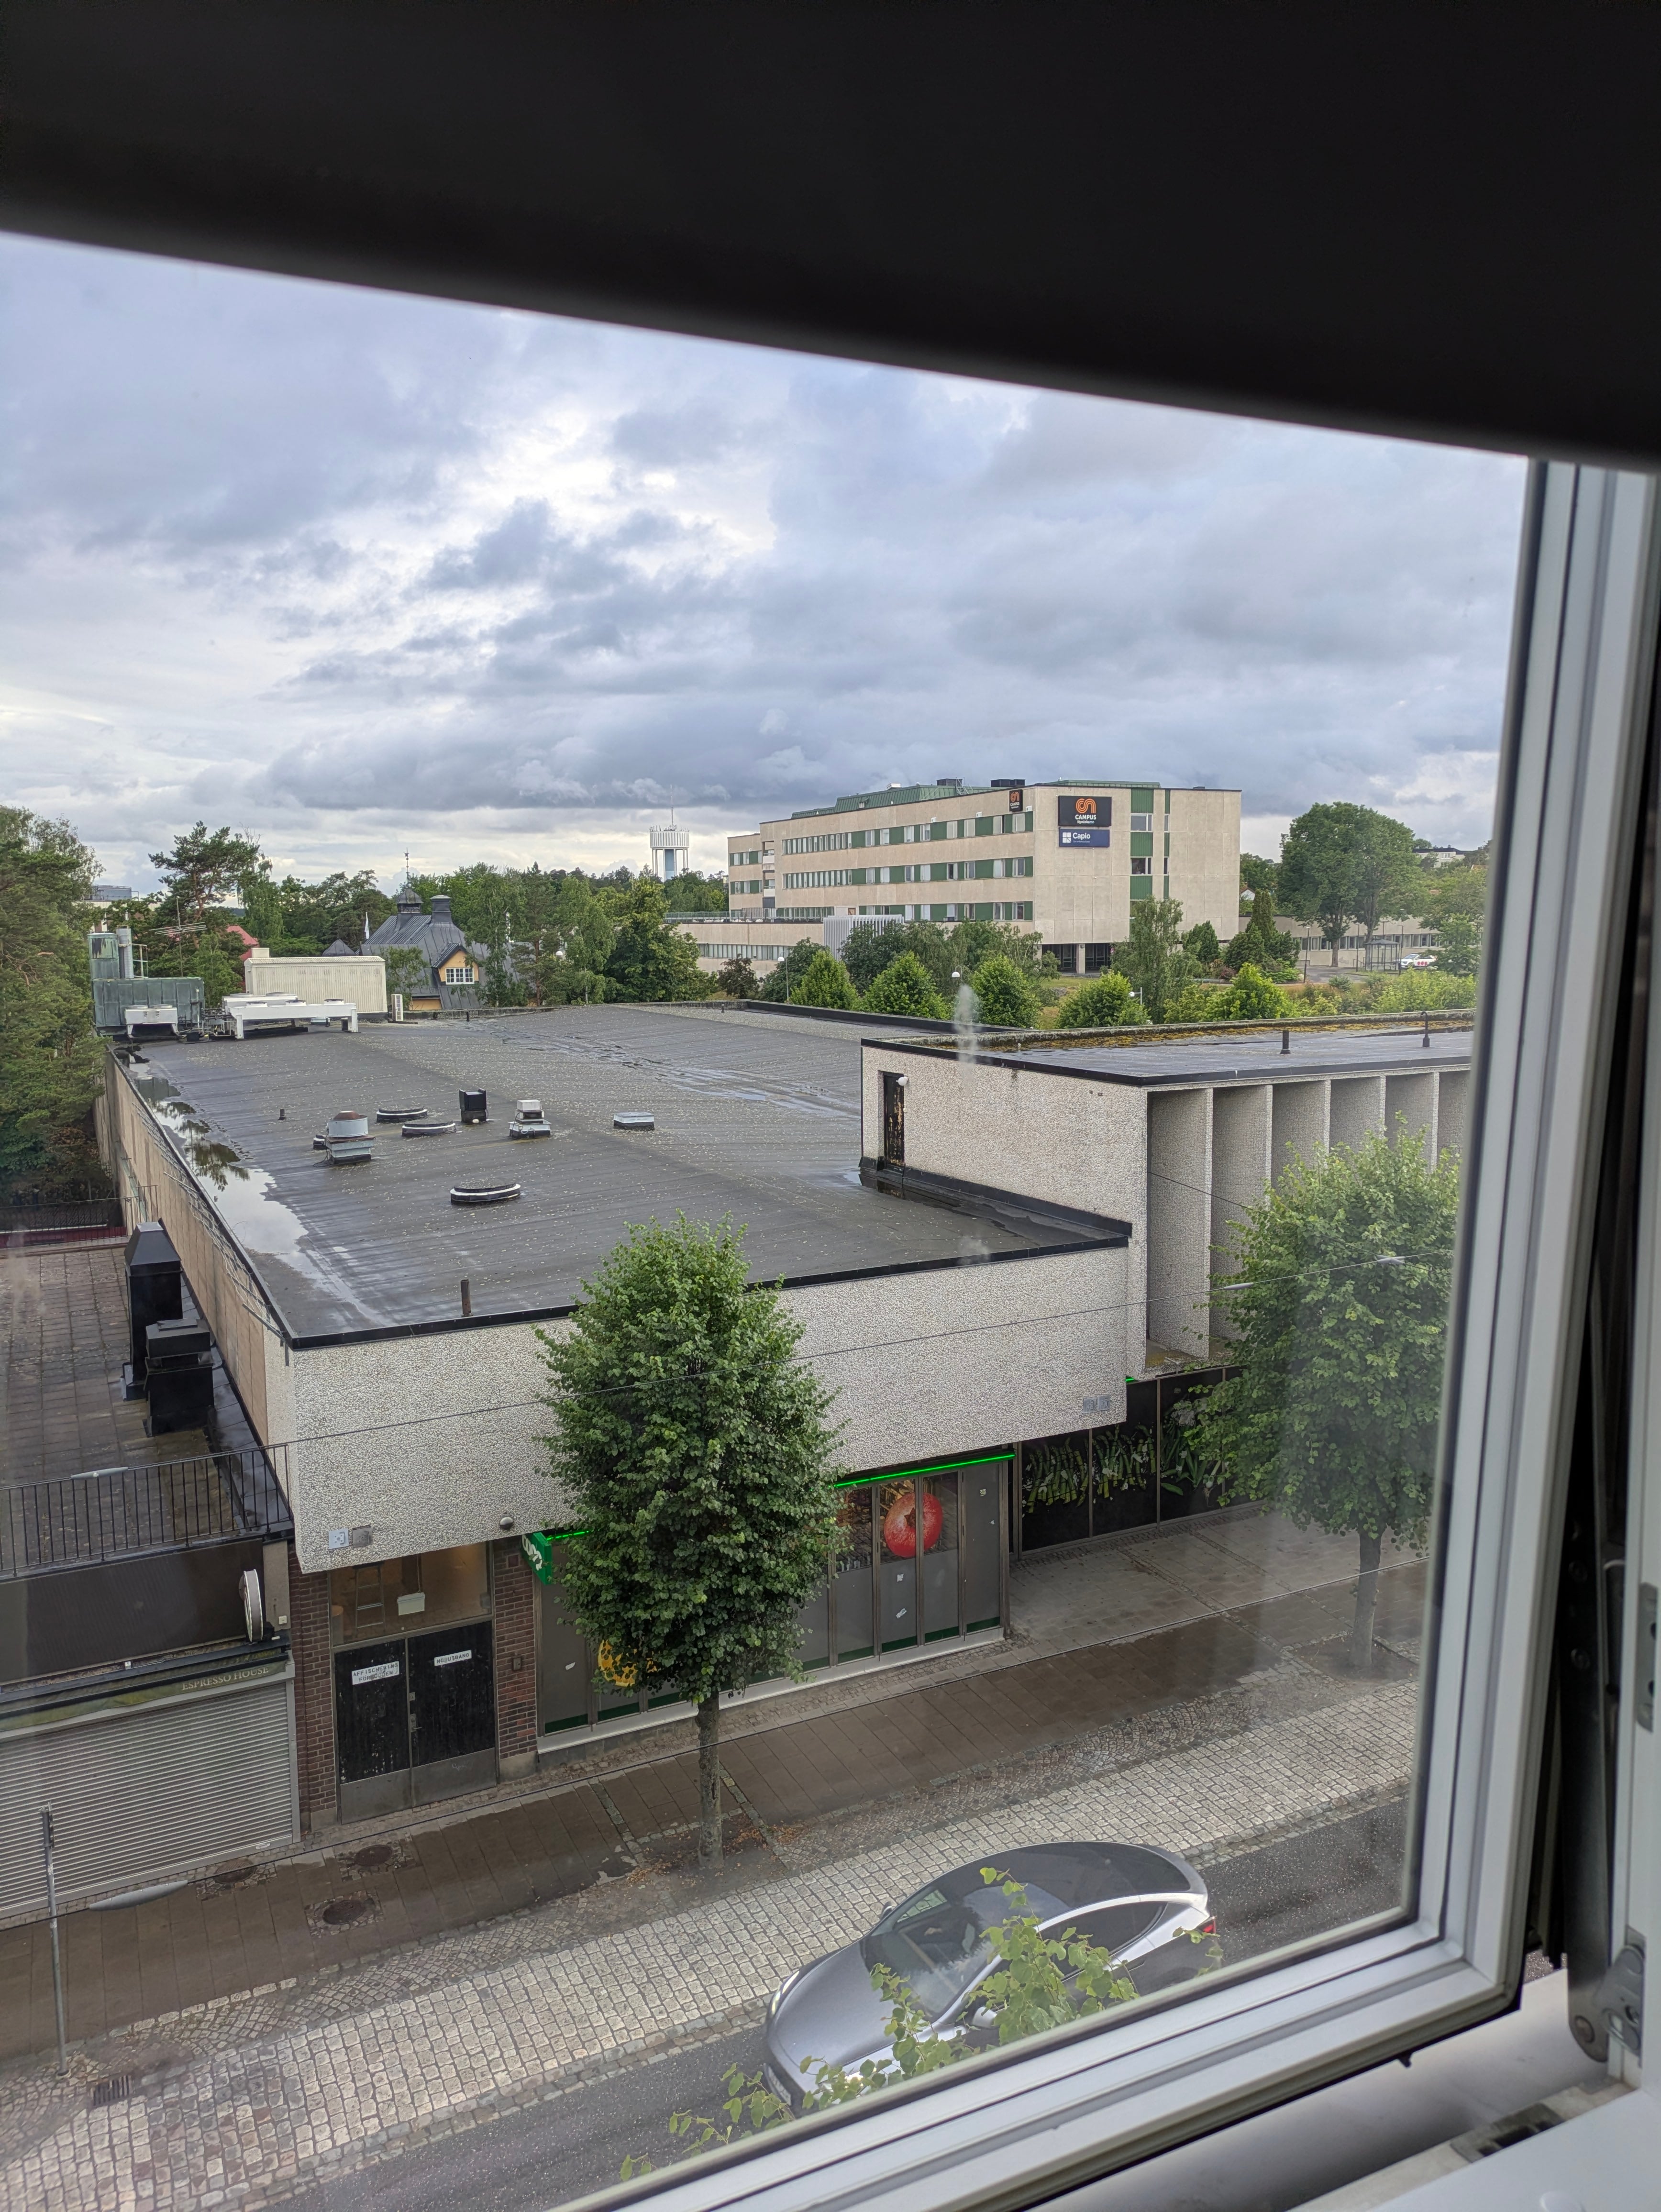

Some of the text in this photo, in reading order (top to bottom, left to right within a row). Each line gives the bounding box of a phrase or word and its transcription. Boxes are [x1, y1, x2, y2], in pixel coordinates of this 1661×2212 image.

[437, 1652, 469, 1664] NÖUTGÅNG
[353, 1662, 398, 1677] AFFISCHERING
[182, 1667, 269, 1691] ESPRESSO HOUSE
